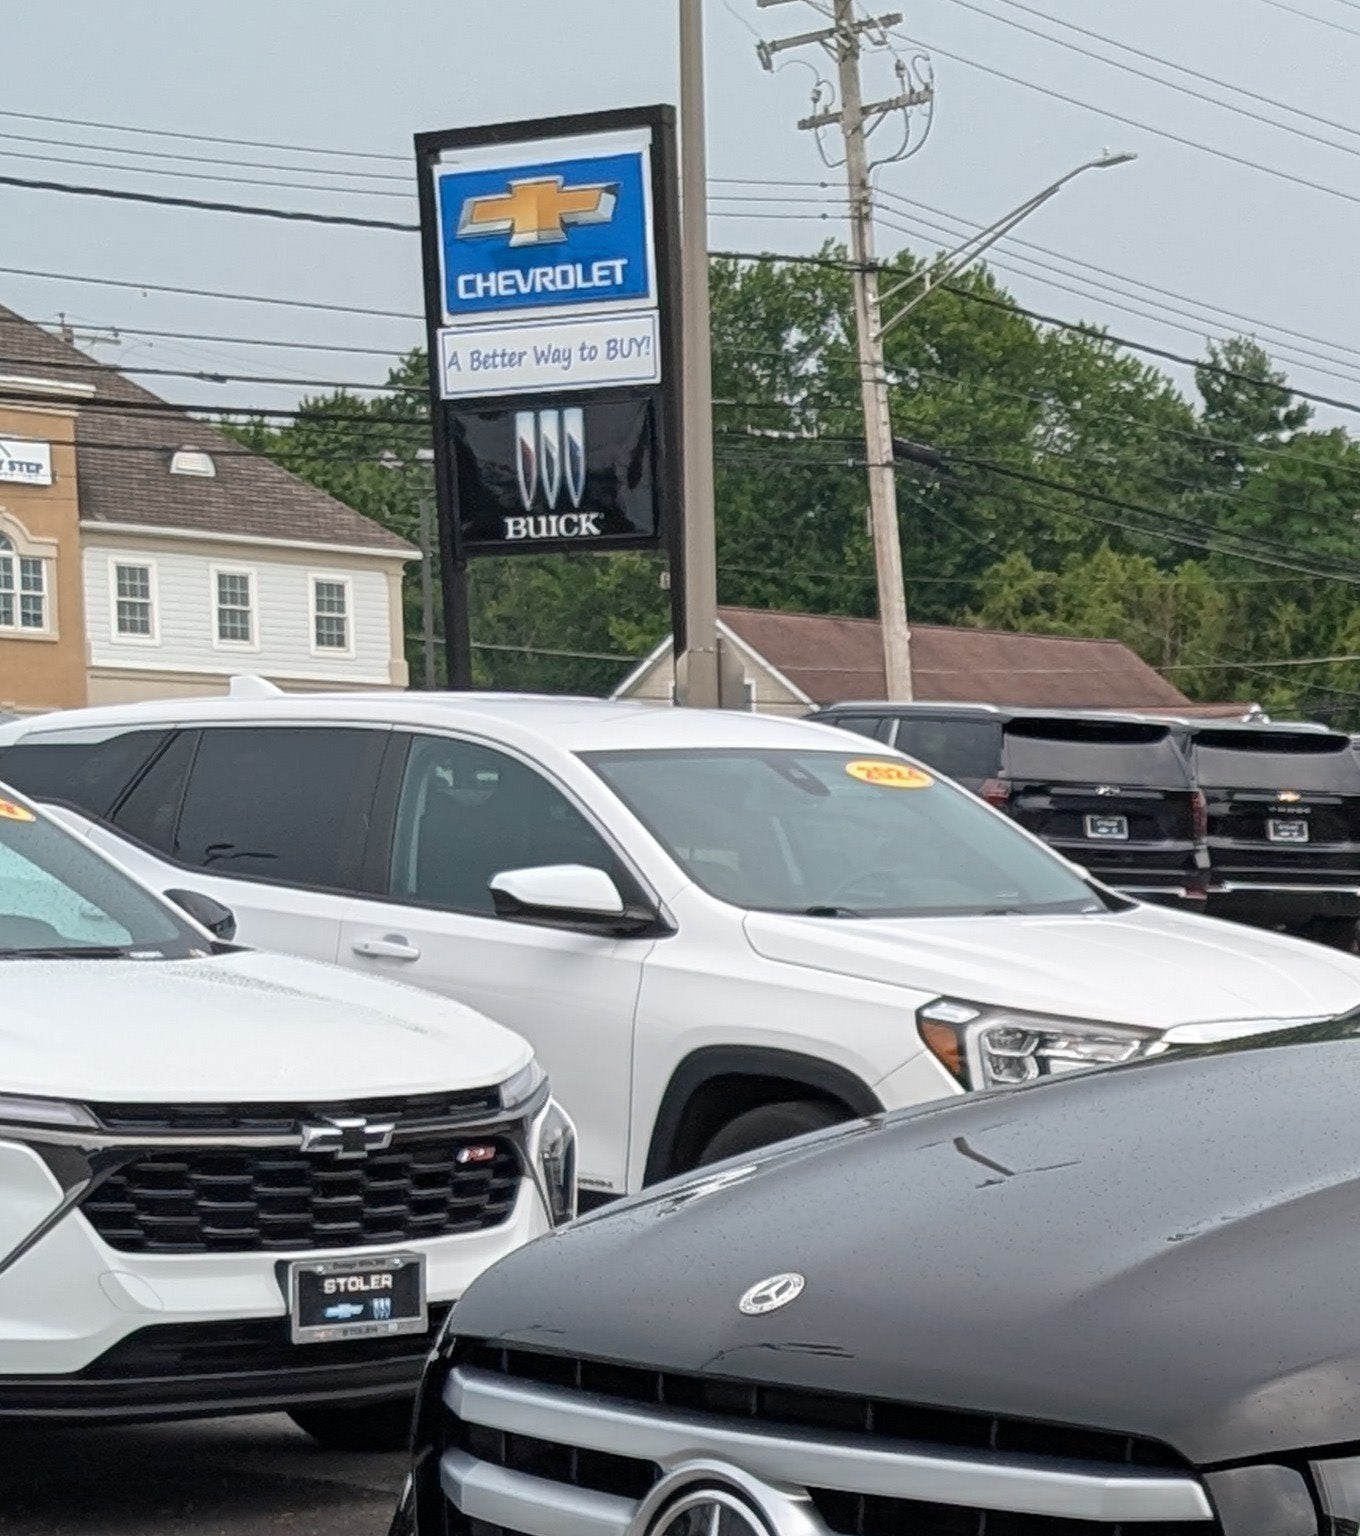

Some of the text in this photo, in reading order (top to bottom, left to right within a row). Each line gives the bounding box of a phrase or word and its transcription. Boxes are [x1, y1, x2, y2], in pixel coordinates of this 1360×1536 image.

[457, 258, 628, 300] CHEVROLET
[447, 336, 651, 372] A Better Way to BUY!
[504, 512, 601, 540] BUICK
[323, 1273, 393, 1295] STOLER
